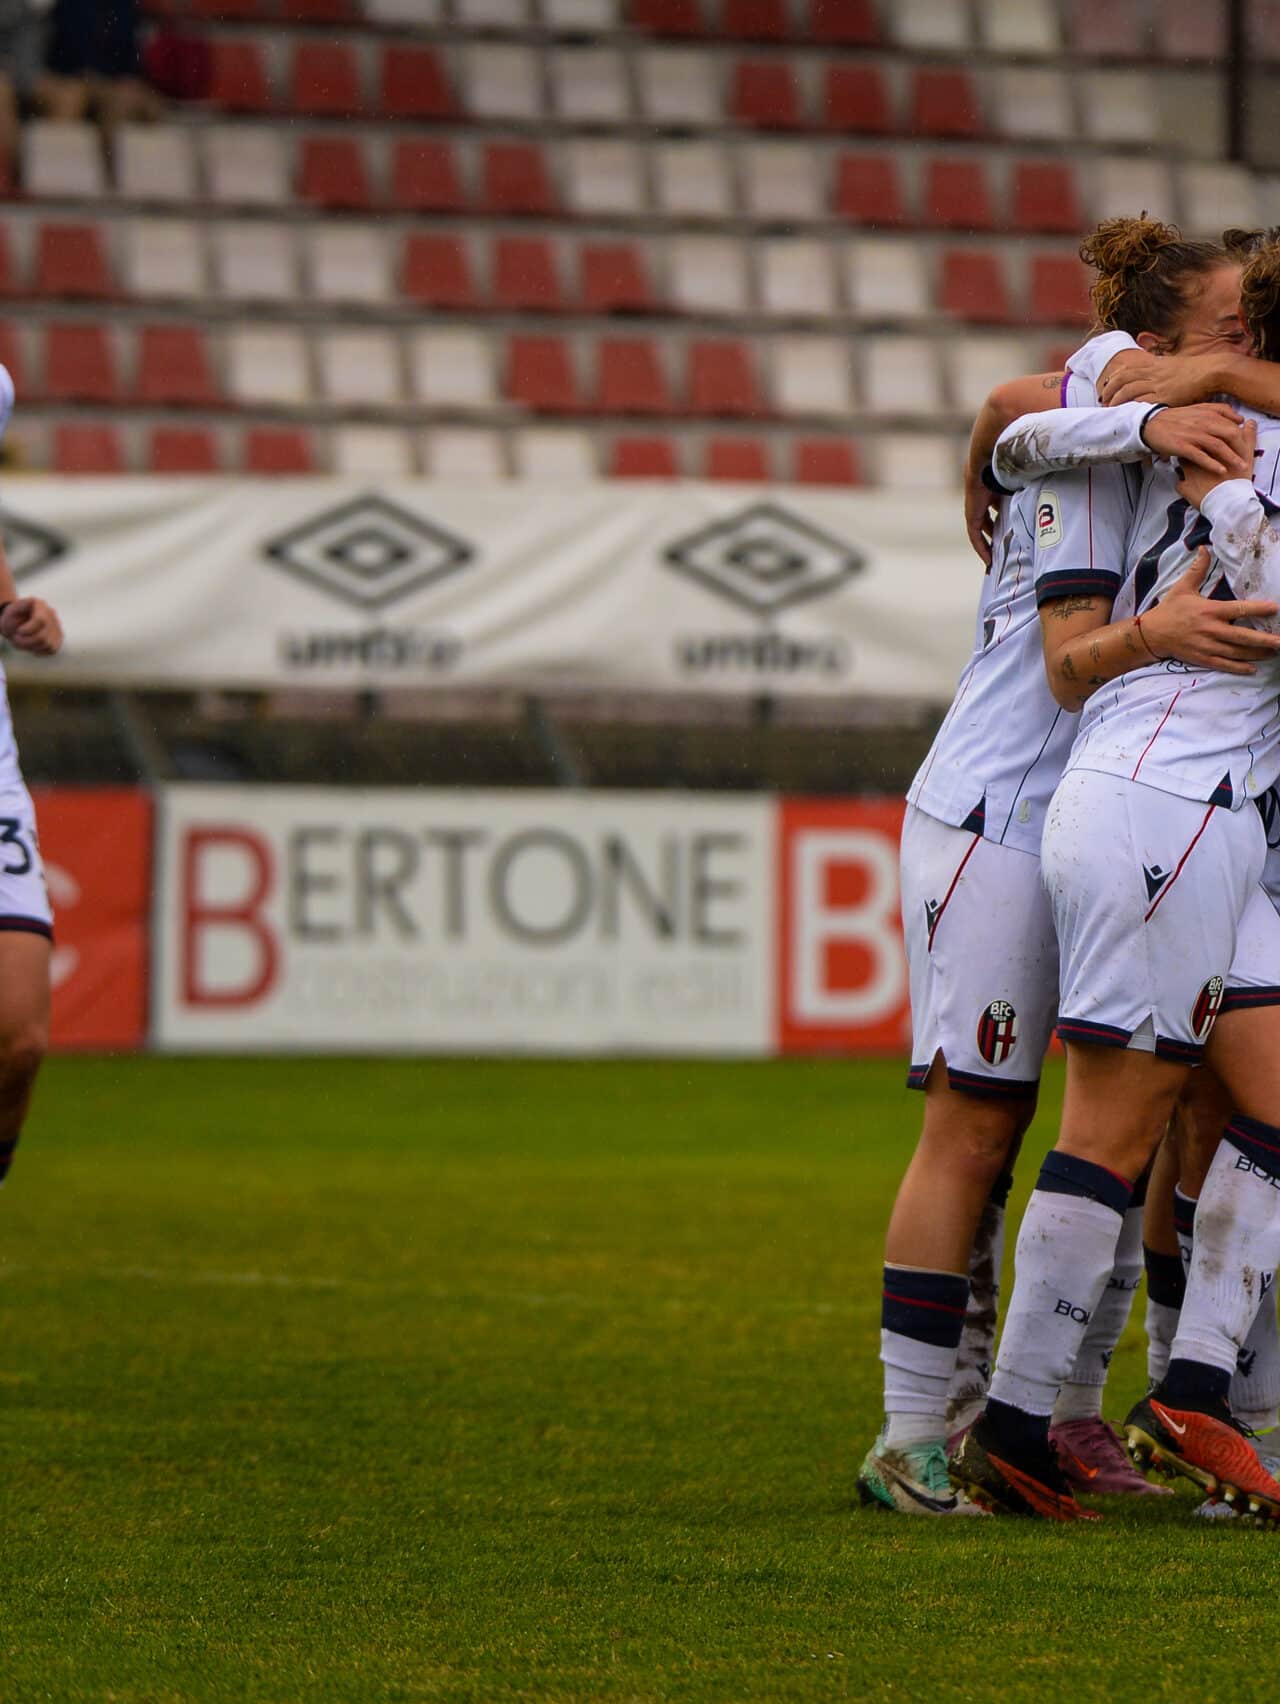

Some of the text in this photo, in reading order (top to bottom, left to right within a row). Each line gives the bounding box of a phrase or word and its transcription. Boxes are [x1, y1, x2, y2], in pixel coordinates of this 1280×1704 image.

[673, 632, 852, 674] umbro
[179, 821, 750, 1012] BERTONE
[990, 1001, 1012, 1017] BFC
